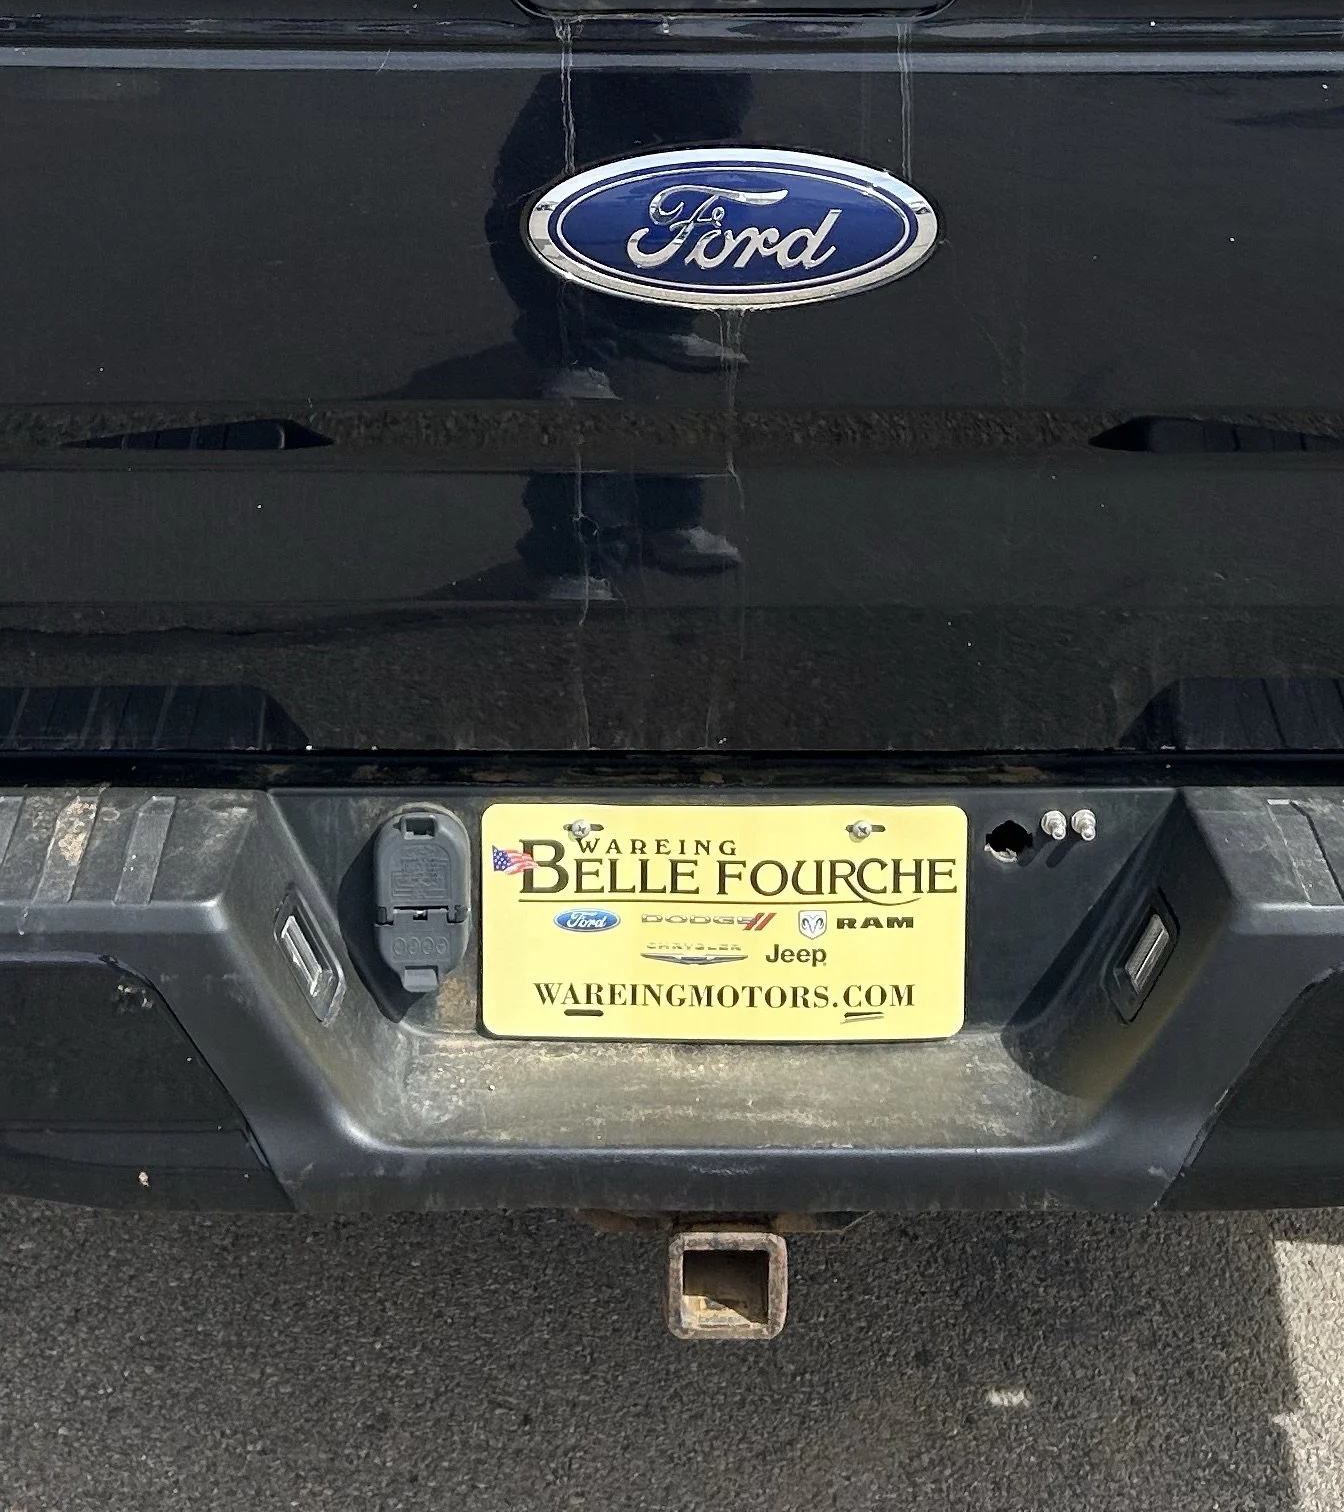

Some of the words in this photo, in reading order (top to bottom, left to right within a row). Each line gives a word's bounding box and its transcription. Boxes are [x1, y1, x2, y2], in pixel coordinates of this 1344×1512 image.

[626, 183, 843, 270] Ford
[576, 837, 737, 855] WAREING
[518, 838, 700, 895] BELLE
[716, 857, 958, 900] FOURCHE
[566, 911, 608, 929] Ford
[641, 913, 758, 925] DODGE
[836, 916, 914, 930] RAM
[765, 943, 828, 968] Jeep
[533, 981, 916, 1010] WAREINGMOTORS.COM
